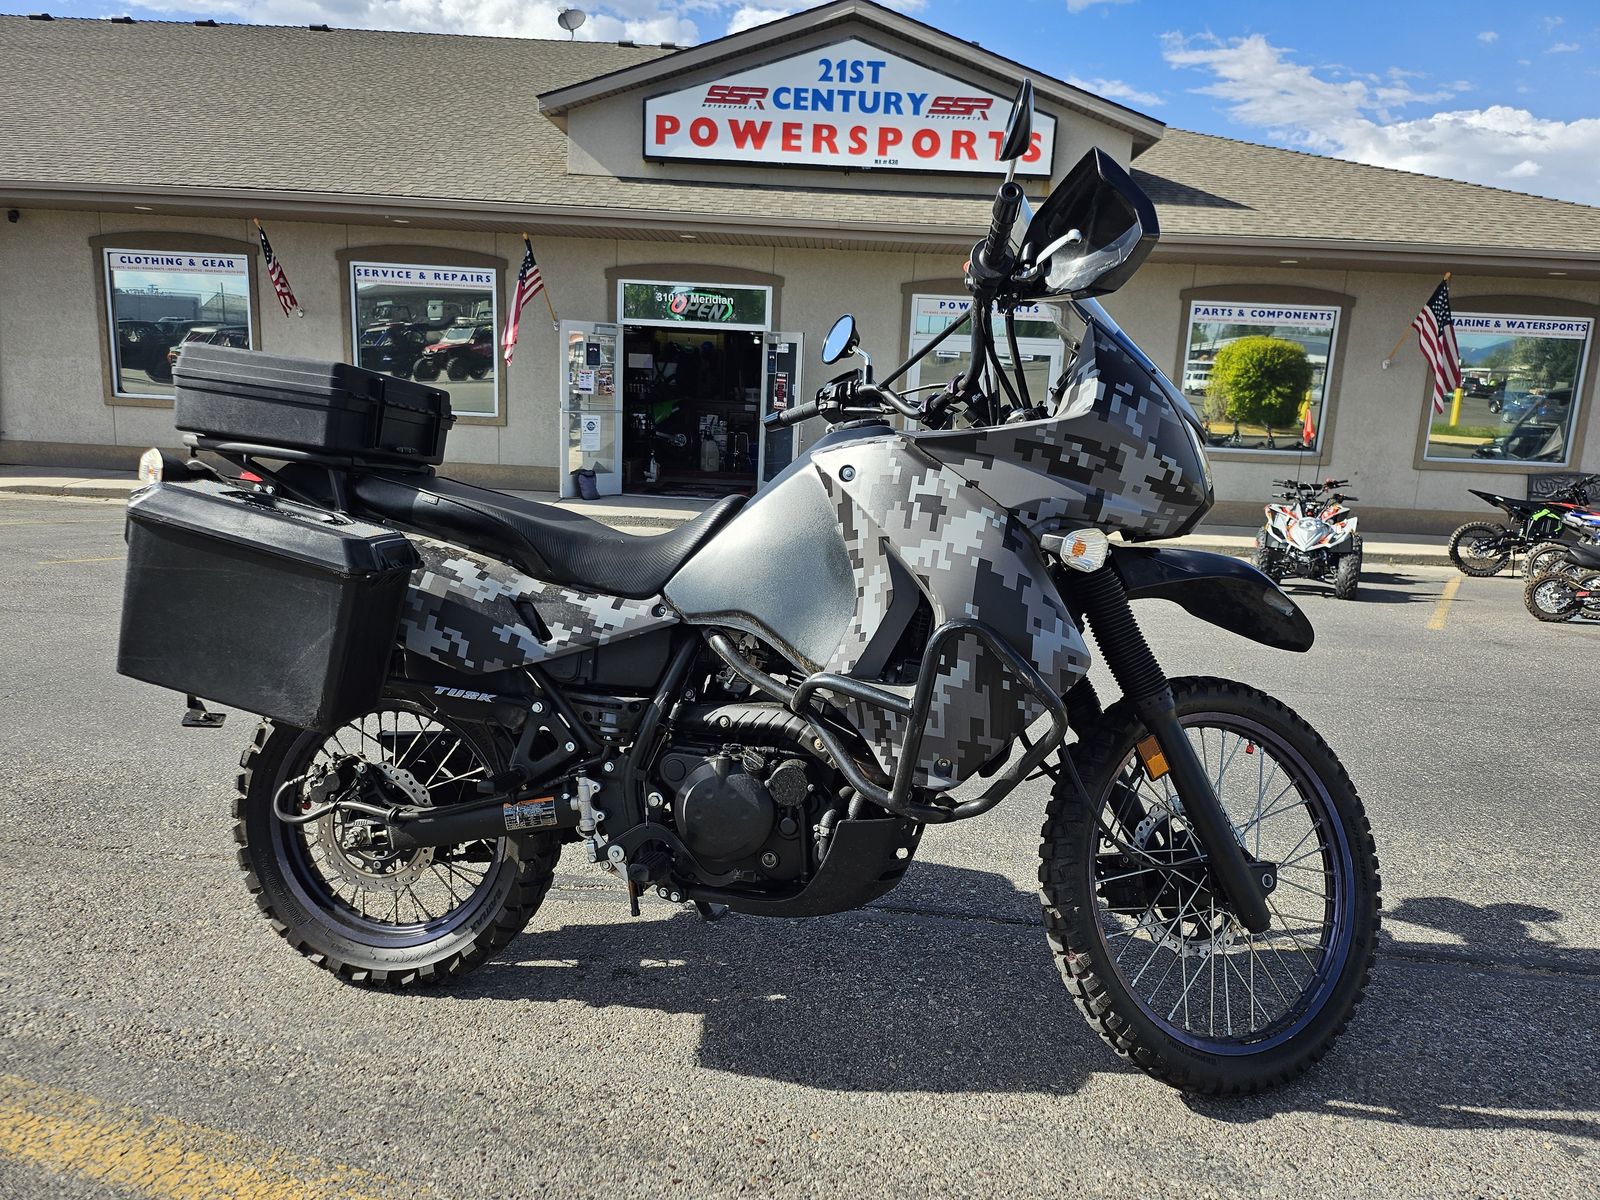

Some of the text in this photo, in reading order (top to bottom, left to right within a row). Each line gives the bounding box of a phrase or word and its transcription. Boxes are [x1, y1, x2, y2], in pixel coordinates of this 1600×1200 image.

[818, 58, 886, 84] 21ST
[704, 85, 769, 110] SSR
[772, 87, 929, 116] CENTURY
[927, 96, 994, 120] SSR
[119, 255, 235, 268] CLOTHING & GEAR
[356, 268, 491, 283] SERVICE & REPAIRS
[656, 292, 674, 302] 310
[690, 293, 734, 305] Meridian
[671, 294, 726, 320] OPEN
[1194, 307, 1332, 321] PARTS & COMPONENTS
[1494, 319, 1501, 328] &
[1506, 320, 1587, 332] WATERSPORTS
[434, 685, 498, 703] TUSK
